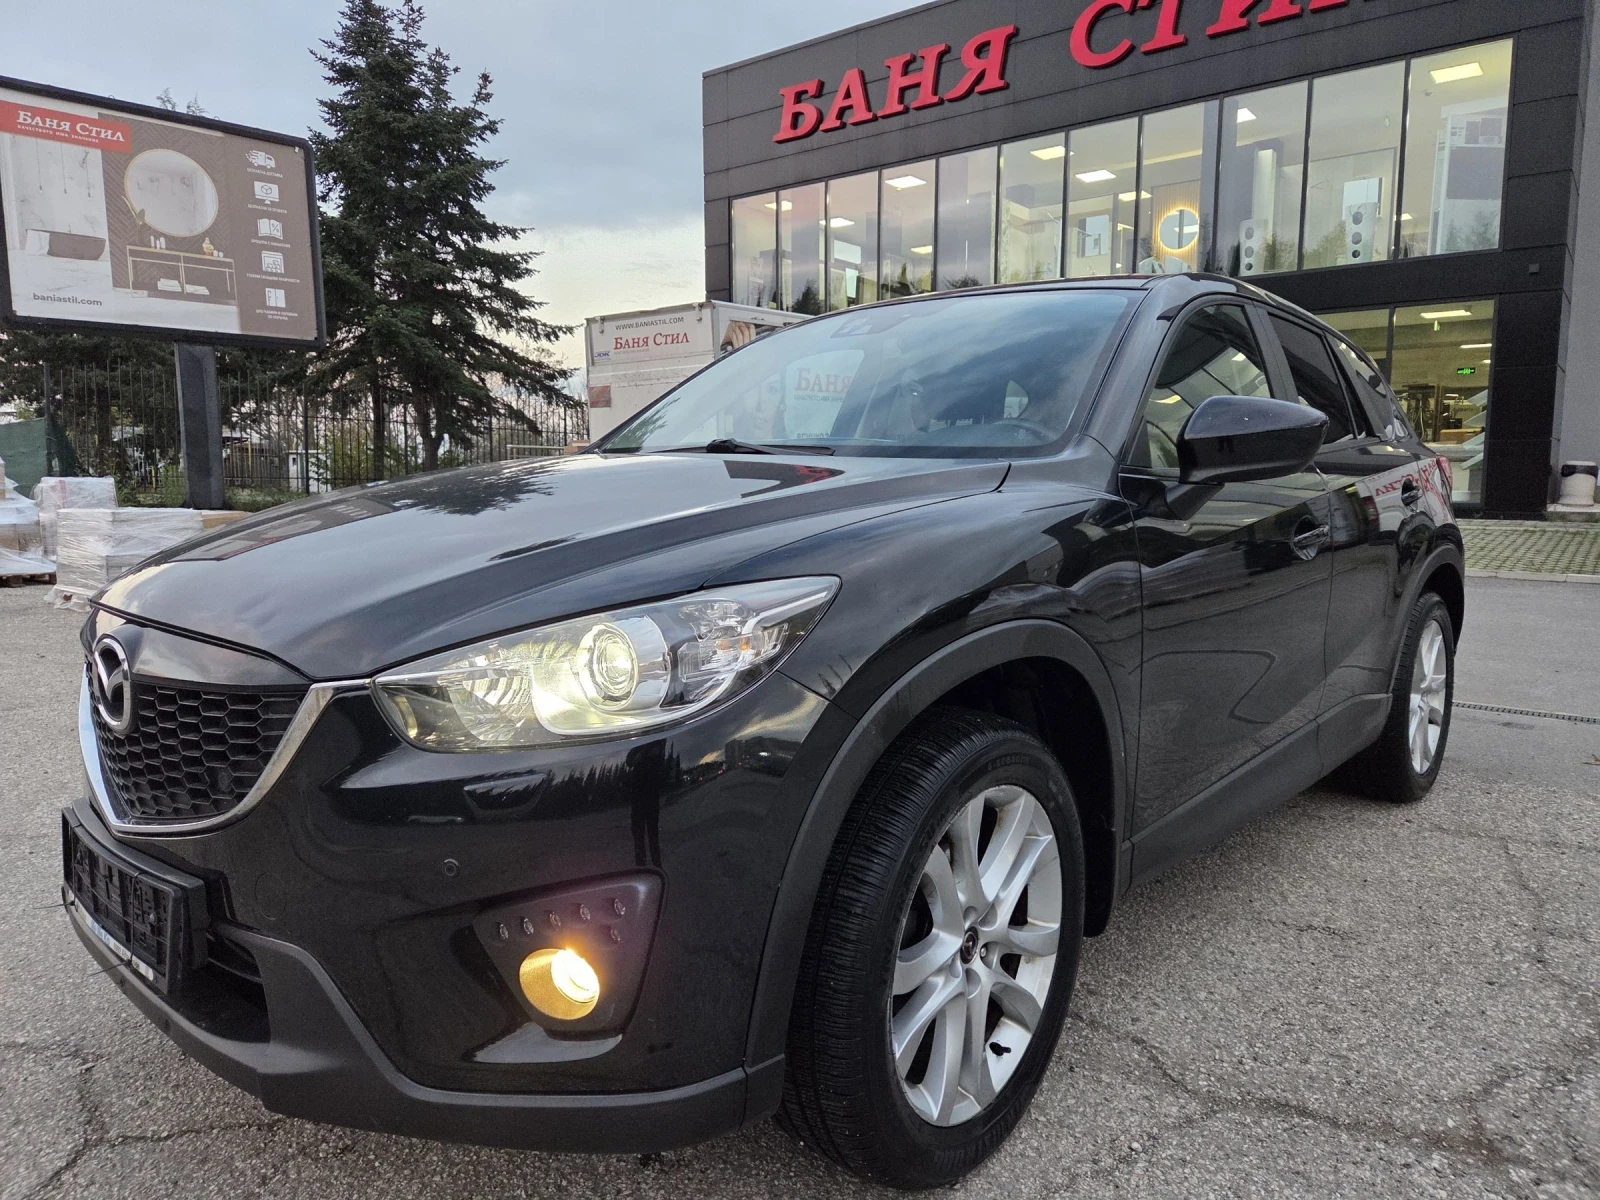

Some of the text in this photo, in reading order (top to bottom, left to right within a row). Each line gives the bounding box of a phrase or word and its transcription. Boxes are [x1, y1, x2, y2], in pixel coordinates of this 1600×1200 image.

[772, 0, 1348, 143] БАНЯ СТ
[16, 110, 125, 142] БАНЯ СТИЛ
[33, 293, 102, 306] baniastil.com
[615, 316, 685, 331] WWW.BANIASTIL.COM
[613, 332, 690, 350] БАНЯ СТИЛ
